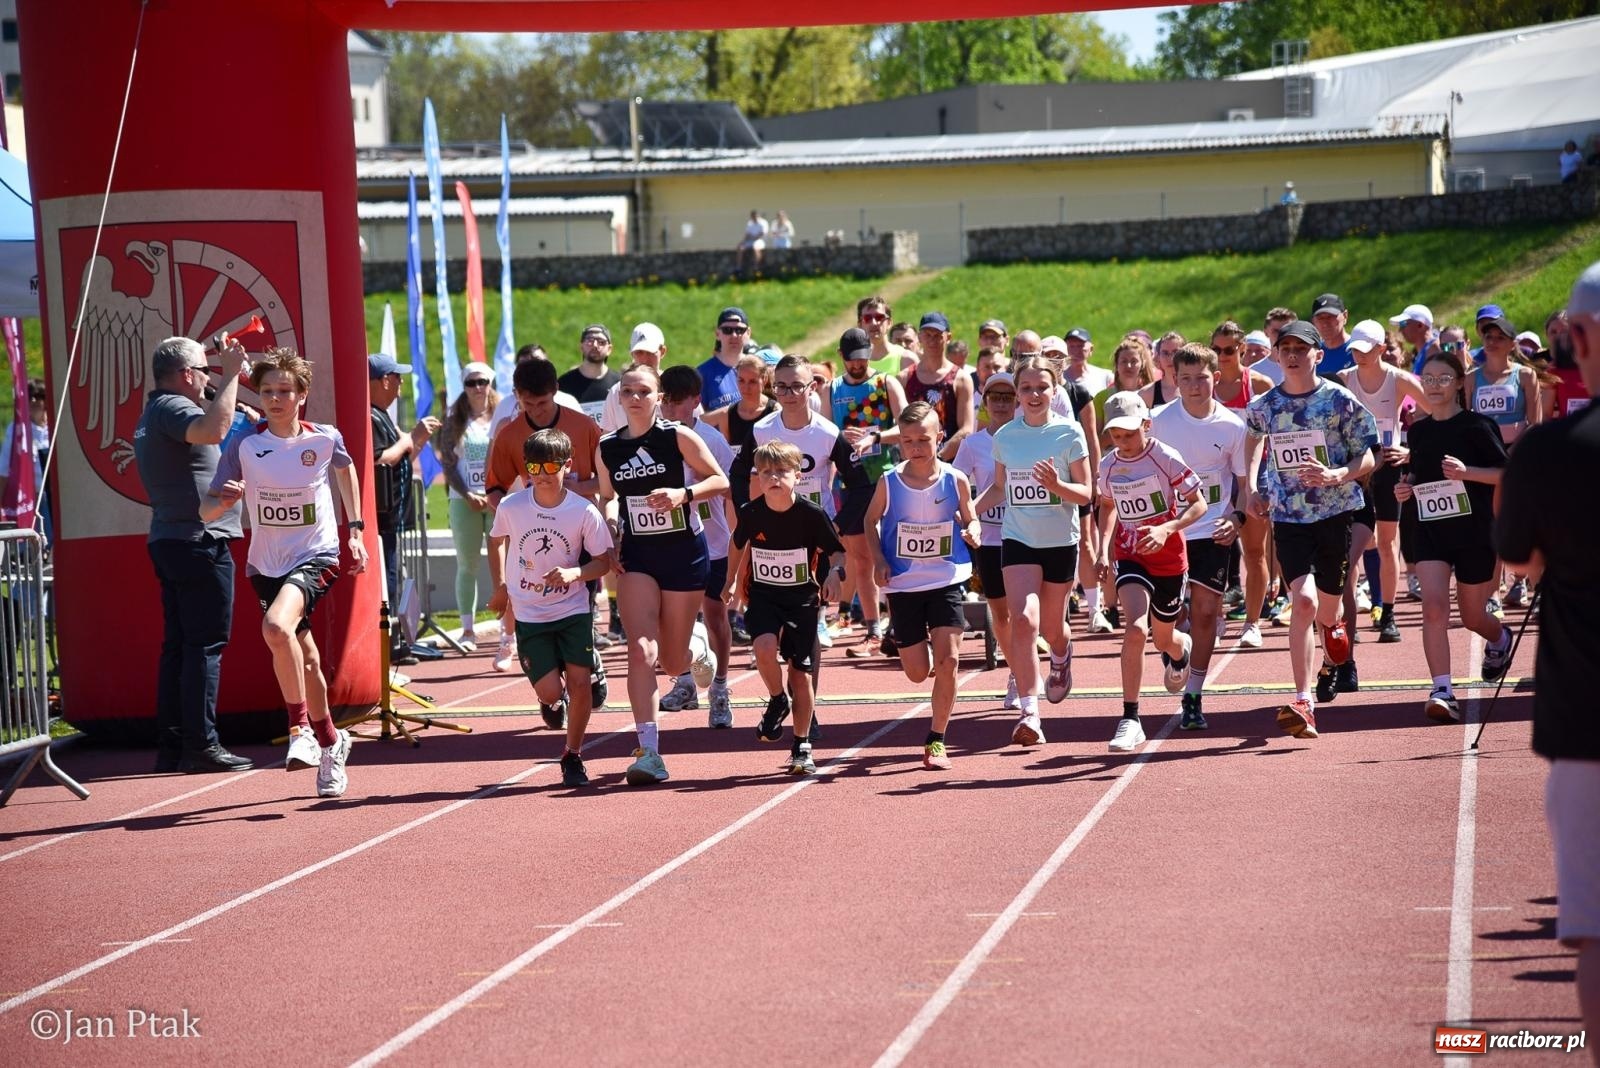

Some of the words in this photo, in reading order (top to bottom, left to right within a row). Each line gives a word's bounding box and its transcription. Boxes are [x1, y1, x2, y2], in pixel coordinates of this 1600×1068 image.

[1480, 397, 1505, 410] 049
[1282, 447, 1310, 464] 015
[614, 463, 666, 481] adidas
[1014, 485, 1047, 500] 006
[1120, 497, 1147, 514] 010
[1427, 496, 1454, 513] 001
[263, 506, 301, 521] 005
[637, 511, 666, 527] 016
[907, 538, 935, 553] 012
[759, 564, 793, 579] 008
[520, 577, 570, 597] trophy
